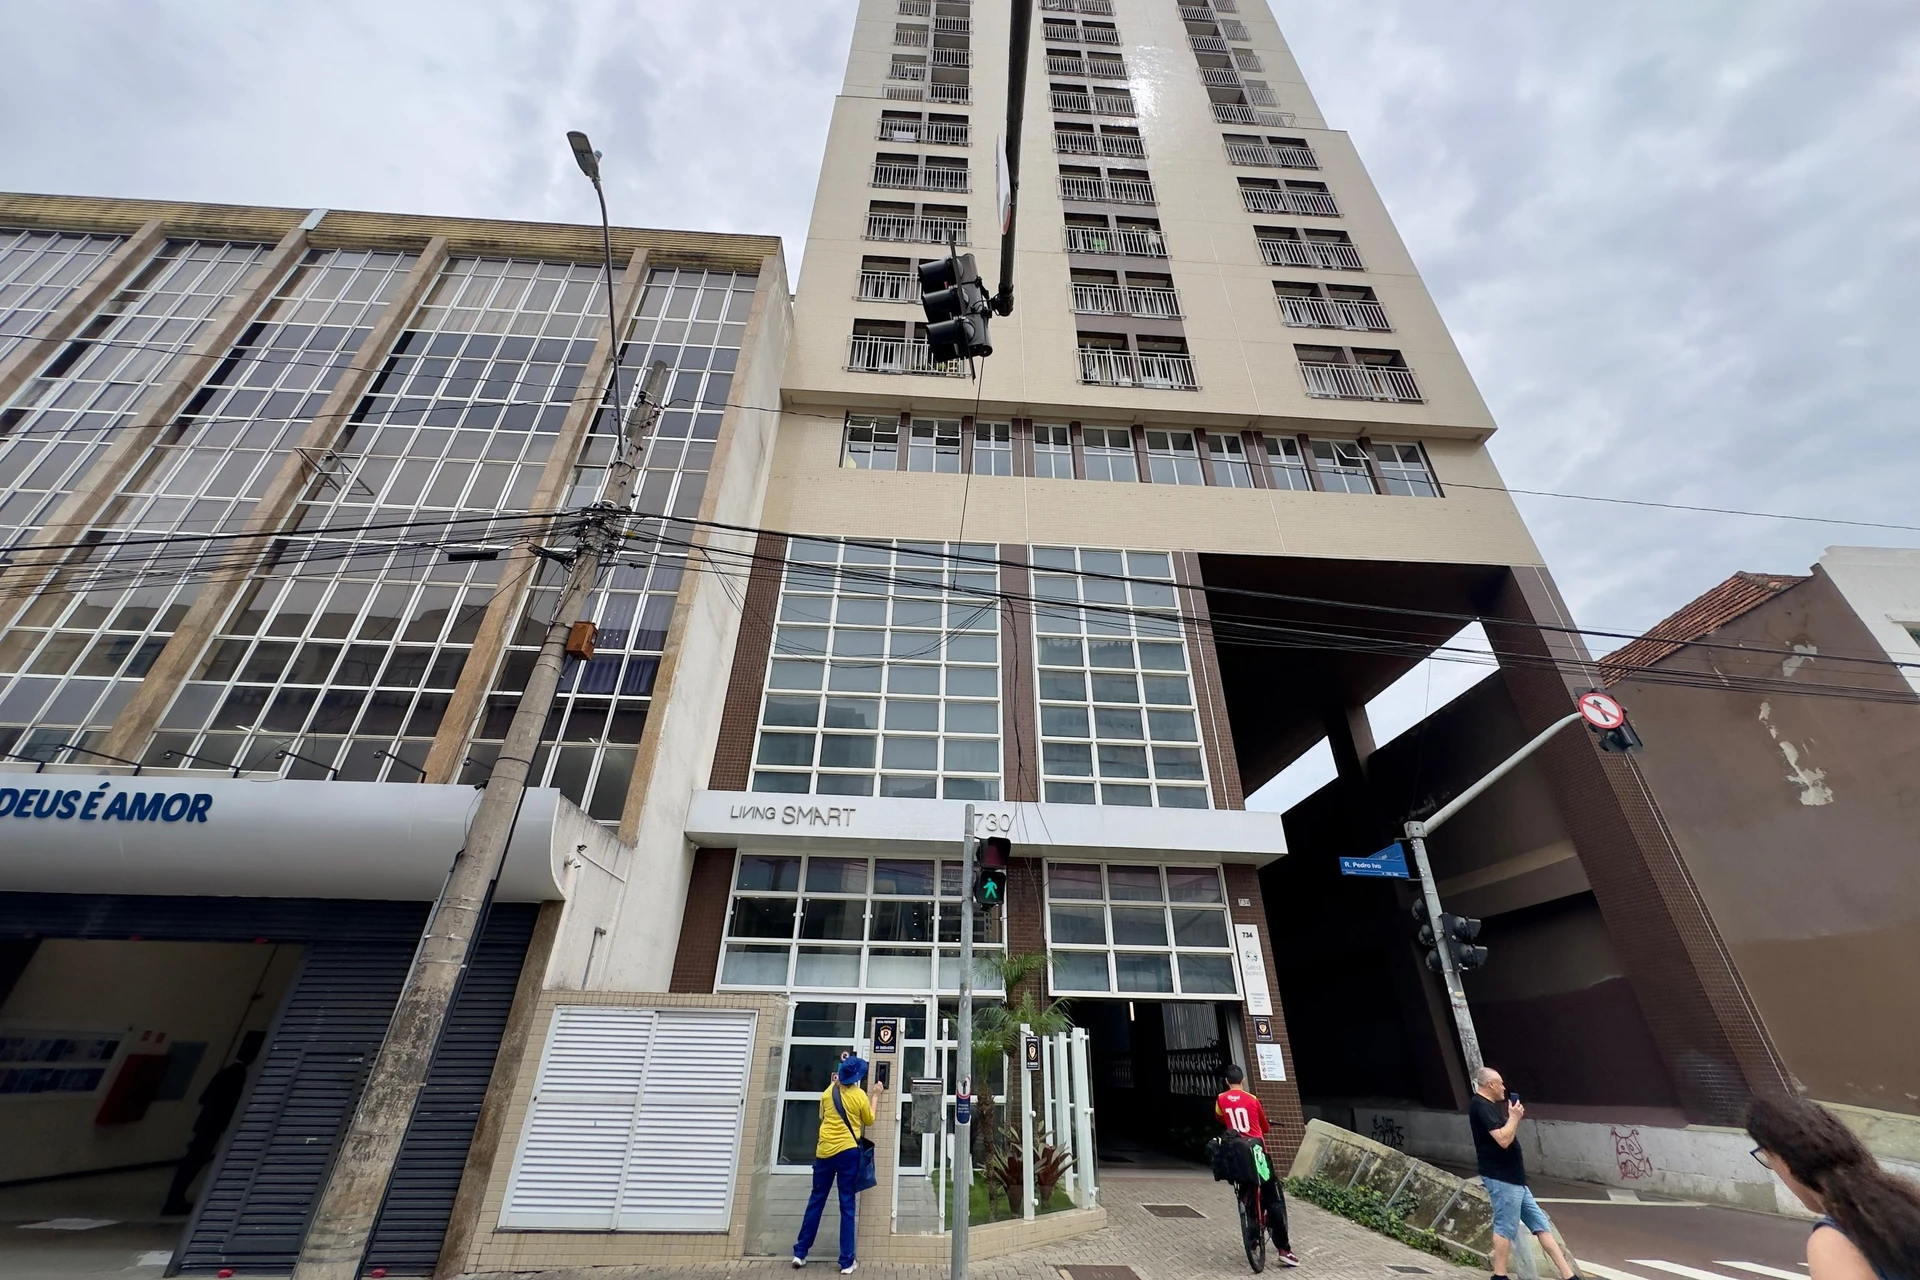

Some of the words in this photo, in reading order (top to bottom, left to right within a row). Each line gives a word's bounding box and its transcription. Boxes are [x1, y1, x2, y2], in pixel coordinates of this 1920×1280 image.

[0, 788, 82, 819] DEUS
[79, 782, 110, 820] É
[102, 792, 213, 823] AMOR
[730, 805, 776, 820] LIVING
[781, 805, 856, 827] SMART
[974, 813, 1010, 832] 730
[1225, 1107, 1250, 1133] 10
